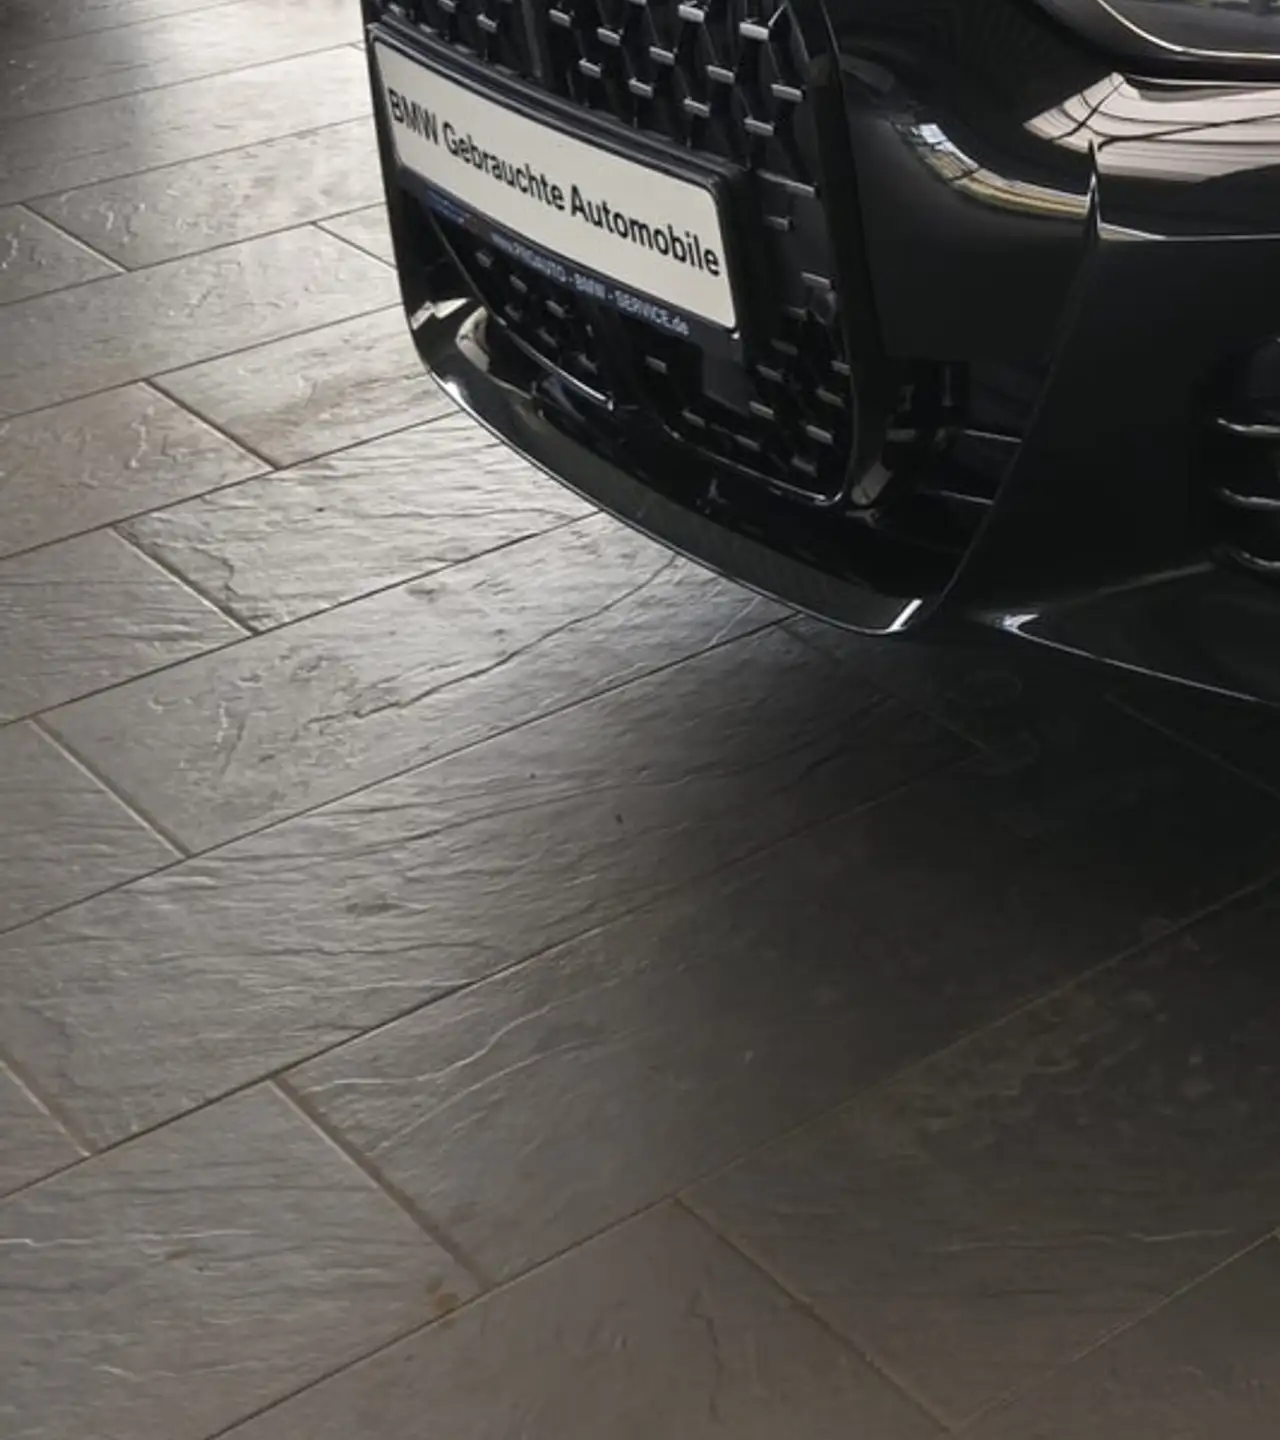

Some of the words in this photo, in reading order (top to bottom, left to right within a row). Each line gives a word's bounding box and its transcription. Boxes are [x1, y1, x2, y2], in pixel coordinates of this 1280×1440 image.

[388, 87, 439, 145] BMW
[443, 121, 566, 211] Gebrauchte
[570, 184, 721, 277] Automobile
